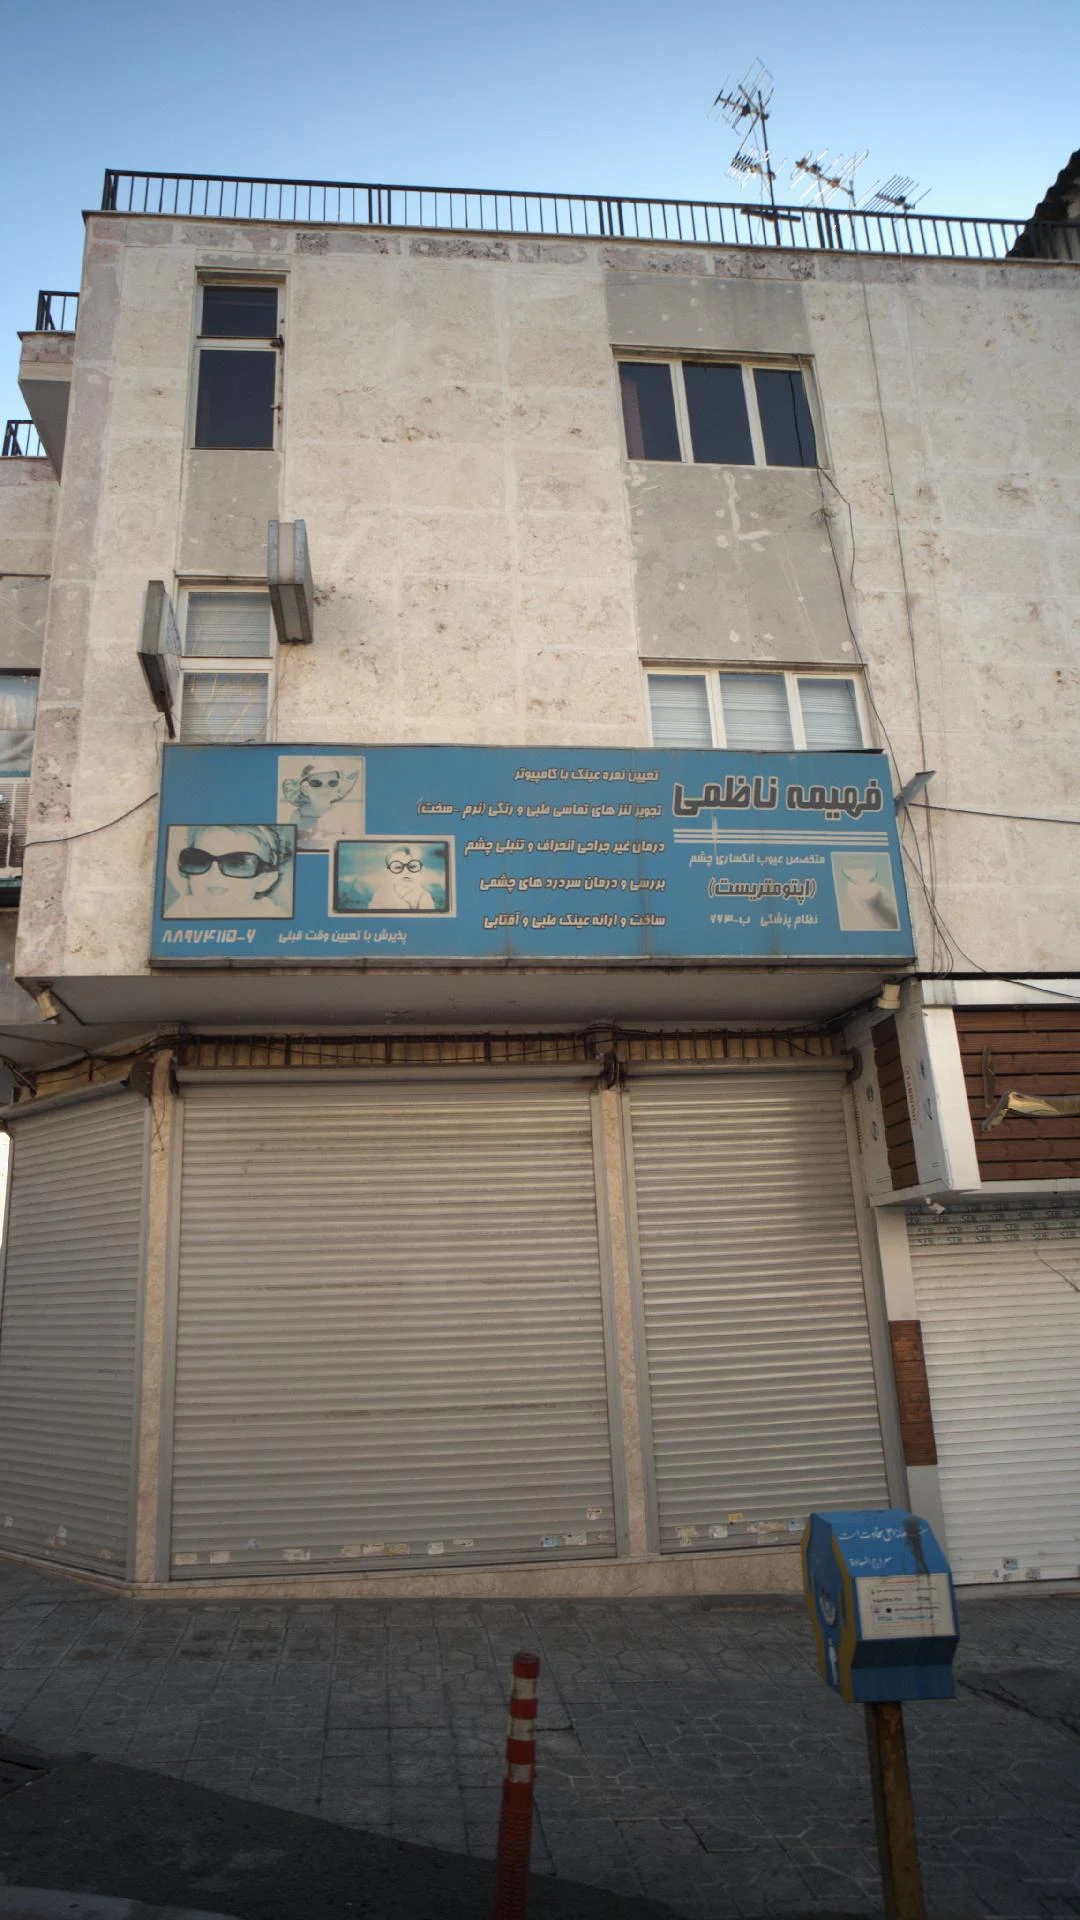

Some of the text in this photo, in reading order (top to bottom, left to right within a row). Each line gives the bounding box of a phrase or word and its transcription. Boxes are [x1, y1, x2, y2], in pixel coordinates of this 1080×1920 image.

[514, 768, 659, 783] تعیین نمره عینک با کامپیوتر
[673, 776, 883, 820] فهیمه ناظمی
[488, 802, 513, 817] رنگی
[517, 805, 522, 817] و
[527, 803, 550, 817] طبی
[553, 803, 589, 817] تماسی
[592, 803, 615, 817] های
[617, 803, 631, 817] لنز
[635, 804, 662, 817] تجویز
[464, 837, 665, 856] درمان غیر جراحی انحراف و تنبلی چشم
[689, 851, 825, 867] متخصص عیوب انکساری چشم
[479, 873, 666, 892] بررسی و درمان سردرد های چشمی
[708, 876, 817, 905] (اپتومتریست)
[484, 912, 520, 929] آفتابی
[522, 915, 528, 927] و
[531, 914, 556, 929] طبی
[559, 914, 589, 928] عینک
[620, 915, 626, 927] و
[630, 914, 666, 926] ساخت
[760, 912, 791, 928] پزشکی
[794, 913, 818, 929] نظام
[278, 928, 407, 944] پذیرش با تعیین وقت قبلی
